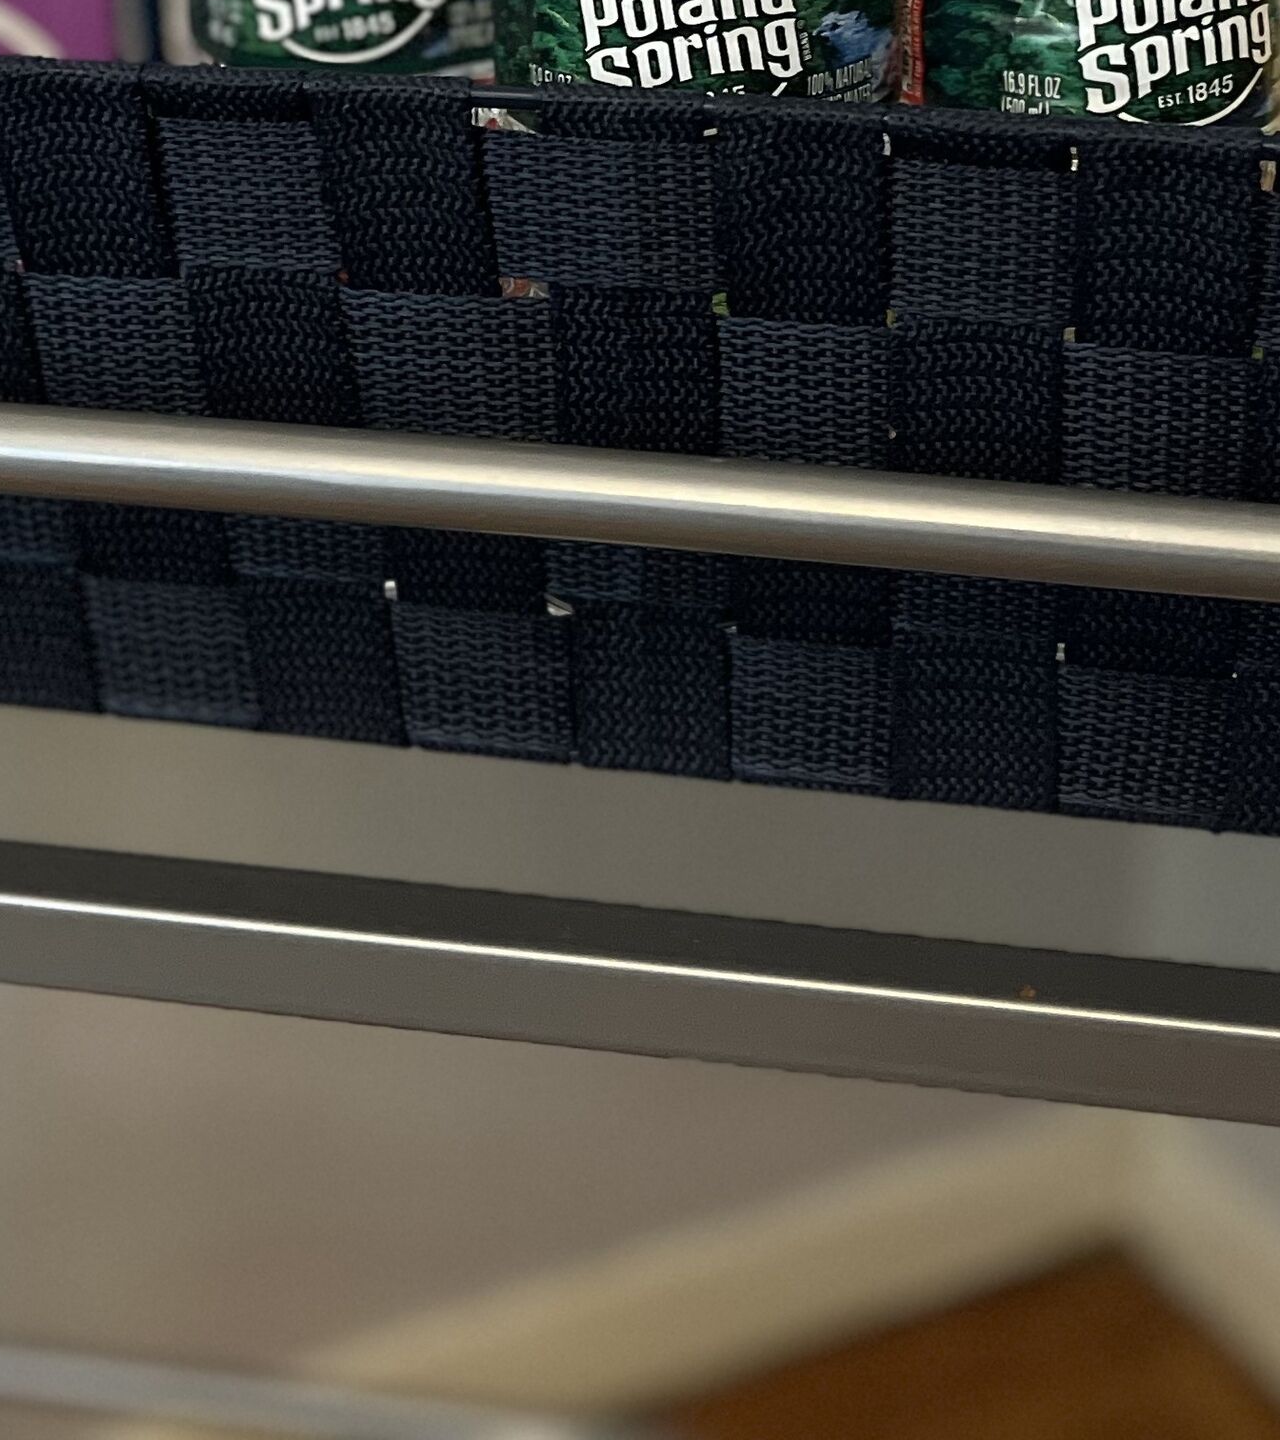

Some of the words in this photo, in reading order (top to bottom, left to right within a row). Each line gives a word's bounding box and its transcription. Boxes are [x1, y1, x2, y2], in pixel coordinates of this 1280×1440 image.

[341, 10, 396, 42] 1845
[585, 18, 803, 88] Spring
[1077, 3, 1272, 114] Spring
[1003, 70, 1026, 95] 16.9
[1027, 73, 1042, 98] FL
[1044, 75, 1061, 100] OZ
[1186, 73, 1234, 105] 1845
